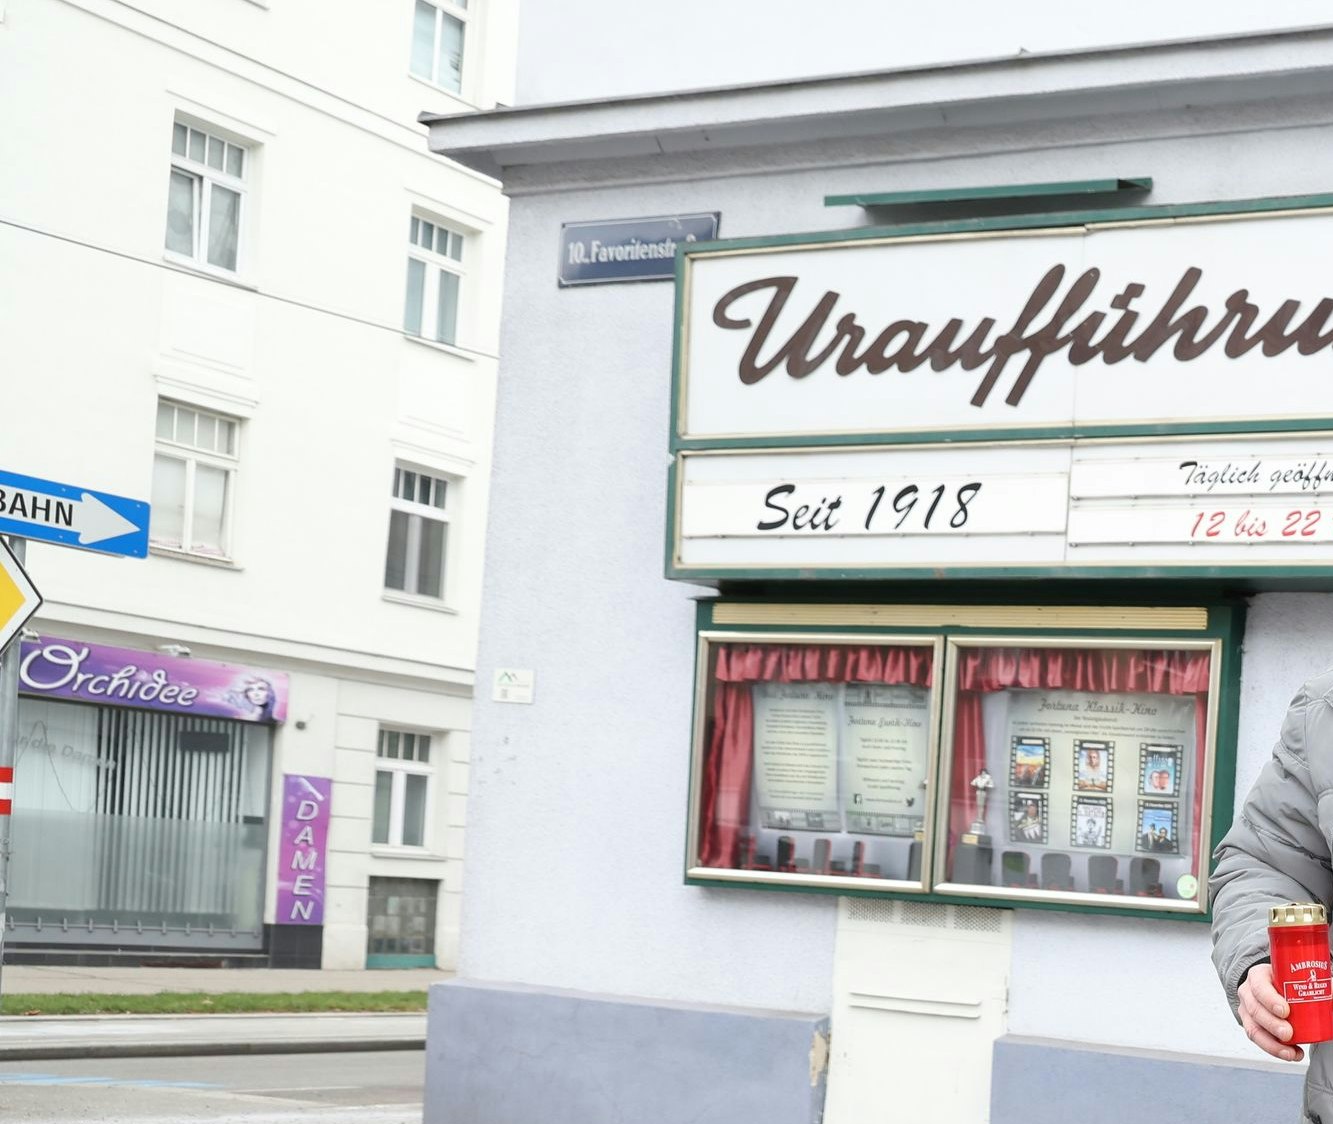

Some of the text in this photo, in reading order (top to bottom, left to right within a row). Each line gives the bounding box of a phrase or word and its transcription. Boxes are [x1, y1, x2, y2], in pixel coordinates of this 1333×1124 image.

[591, 238, 678, 263] Favoritenstr
[1179, 460, 1262, 491] Täglich
[756, 482, 982, 531] Seit 1918
[1190, 511, 1225, 538] 12
[1234, 510, 1268, 537] bis
[1281, 510, 1321, 537] 22
[19, 644, 200, 706] Orchidee
[290, 800, 319, 921] DAMEN
